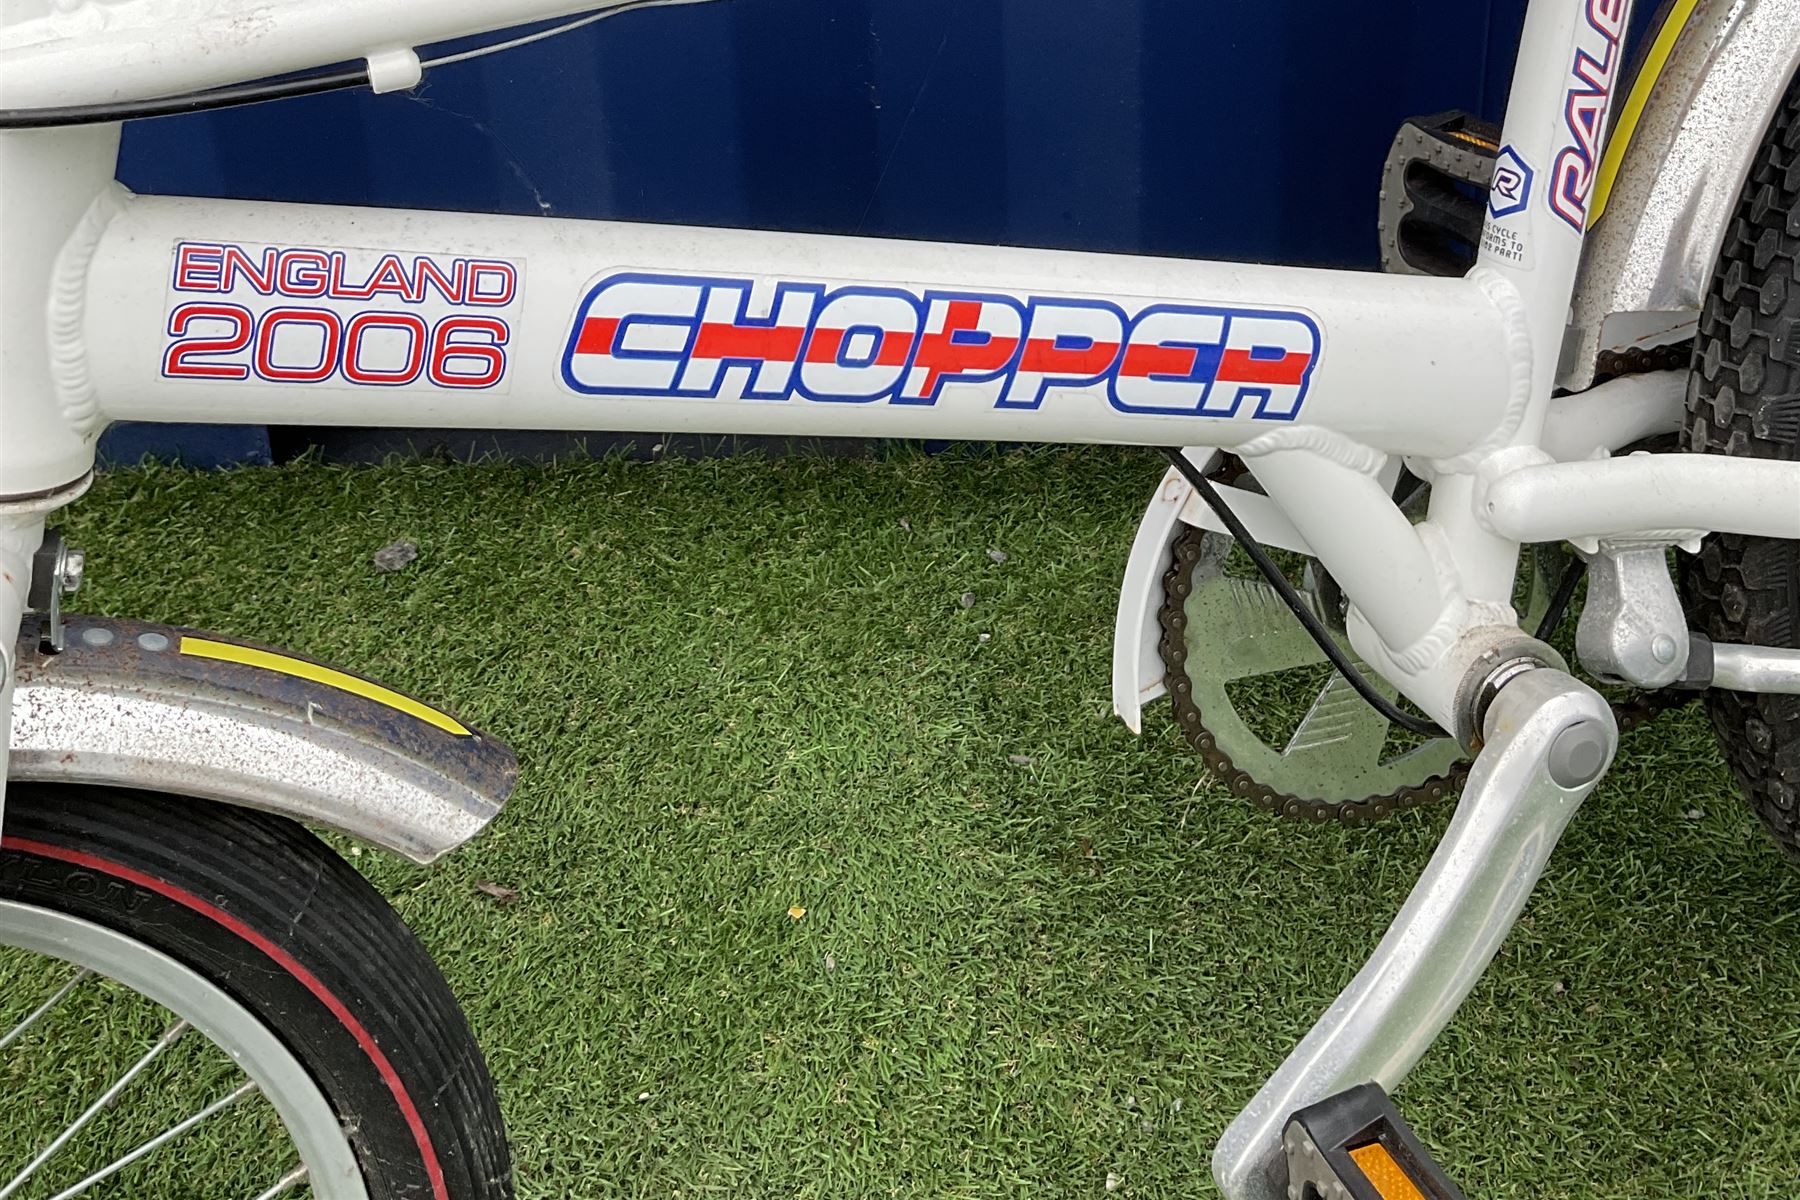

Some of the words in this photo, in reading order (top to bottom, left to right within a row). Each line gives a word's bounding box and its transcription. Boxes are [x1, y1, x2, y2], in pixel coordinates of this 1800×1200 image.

[1492, 224, 1518, 241] CYCLE
[1511, 241, 1524, 252] TO
[173, 242, 517, 306] ENGLAND
[162, 302, 510, 389] 2006
[561, 272, 1322, 420] CHOPPER
